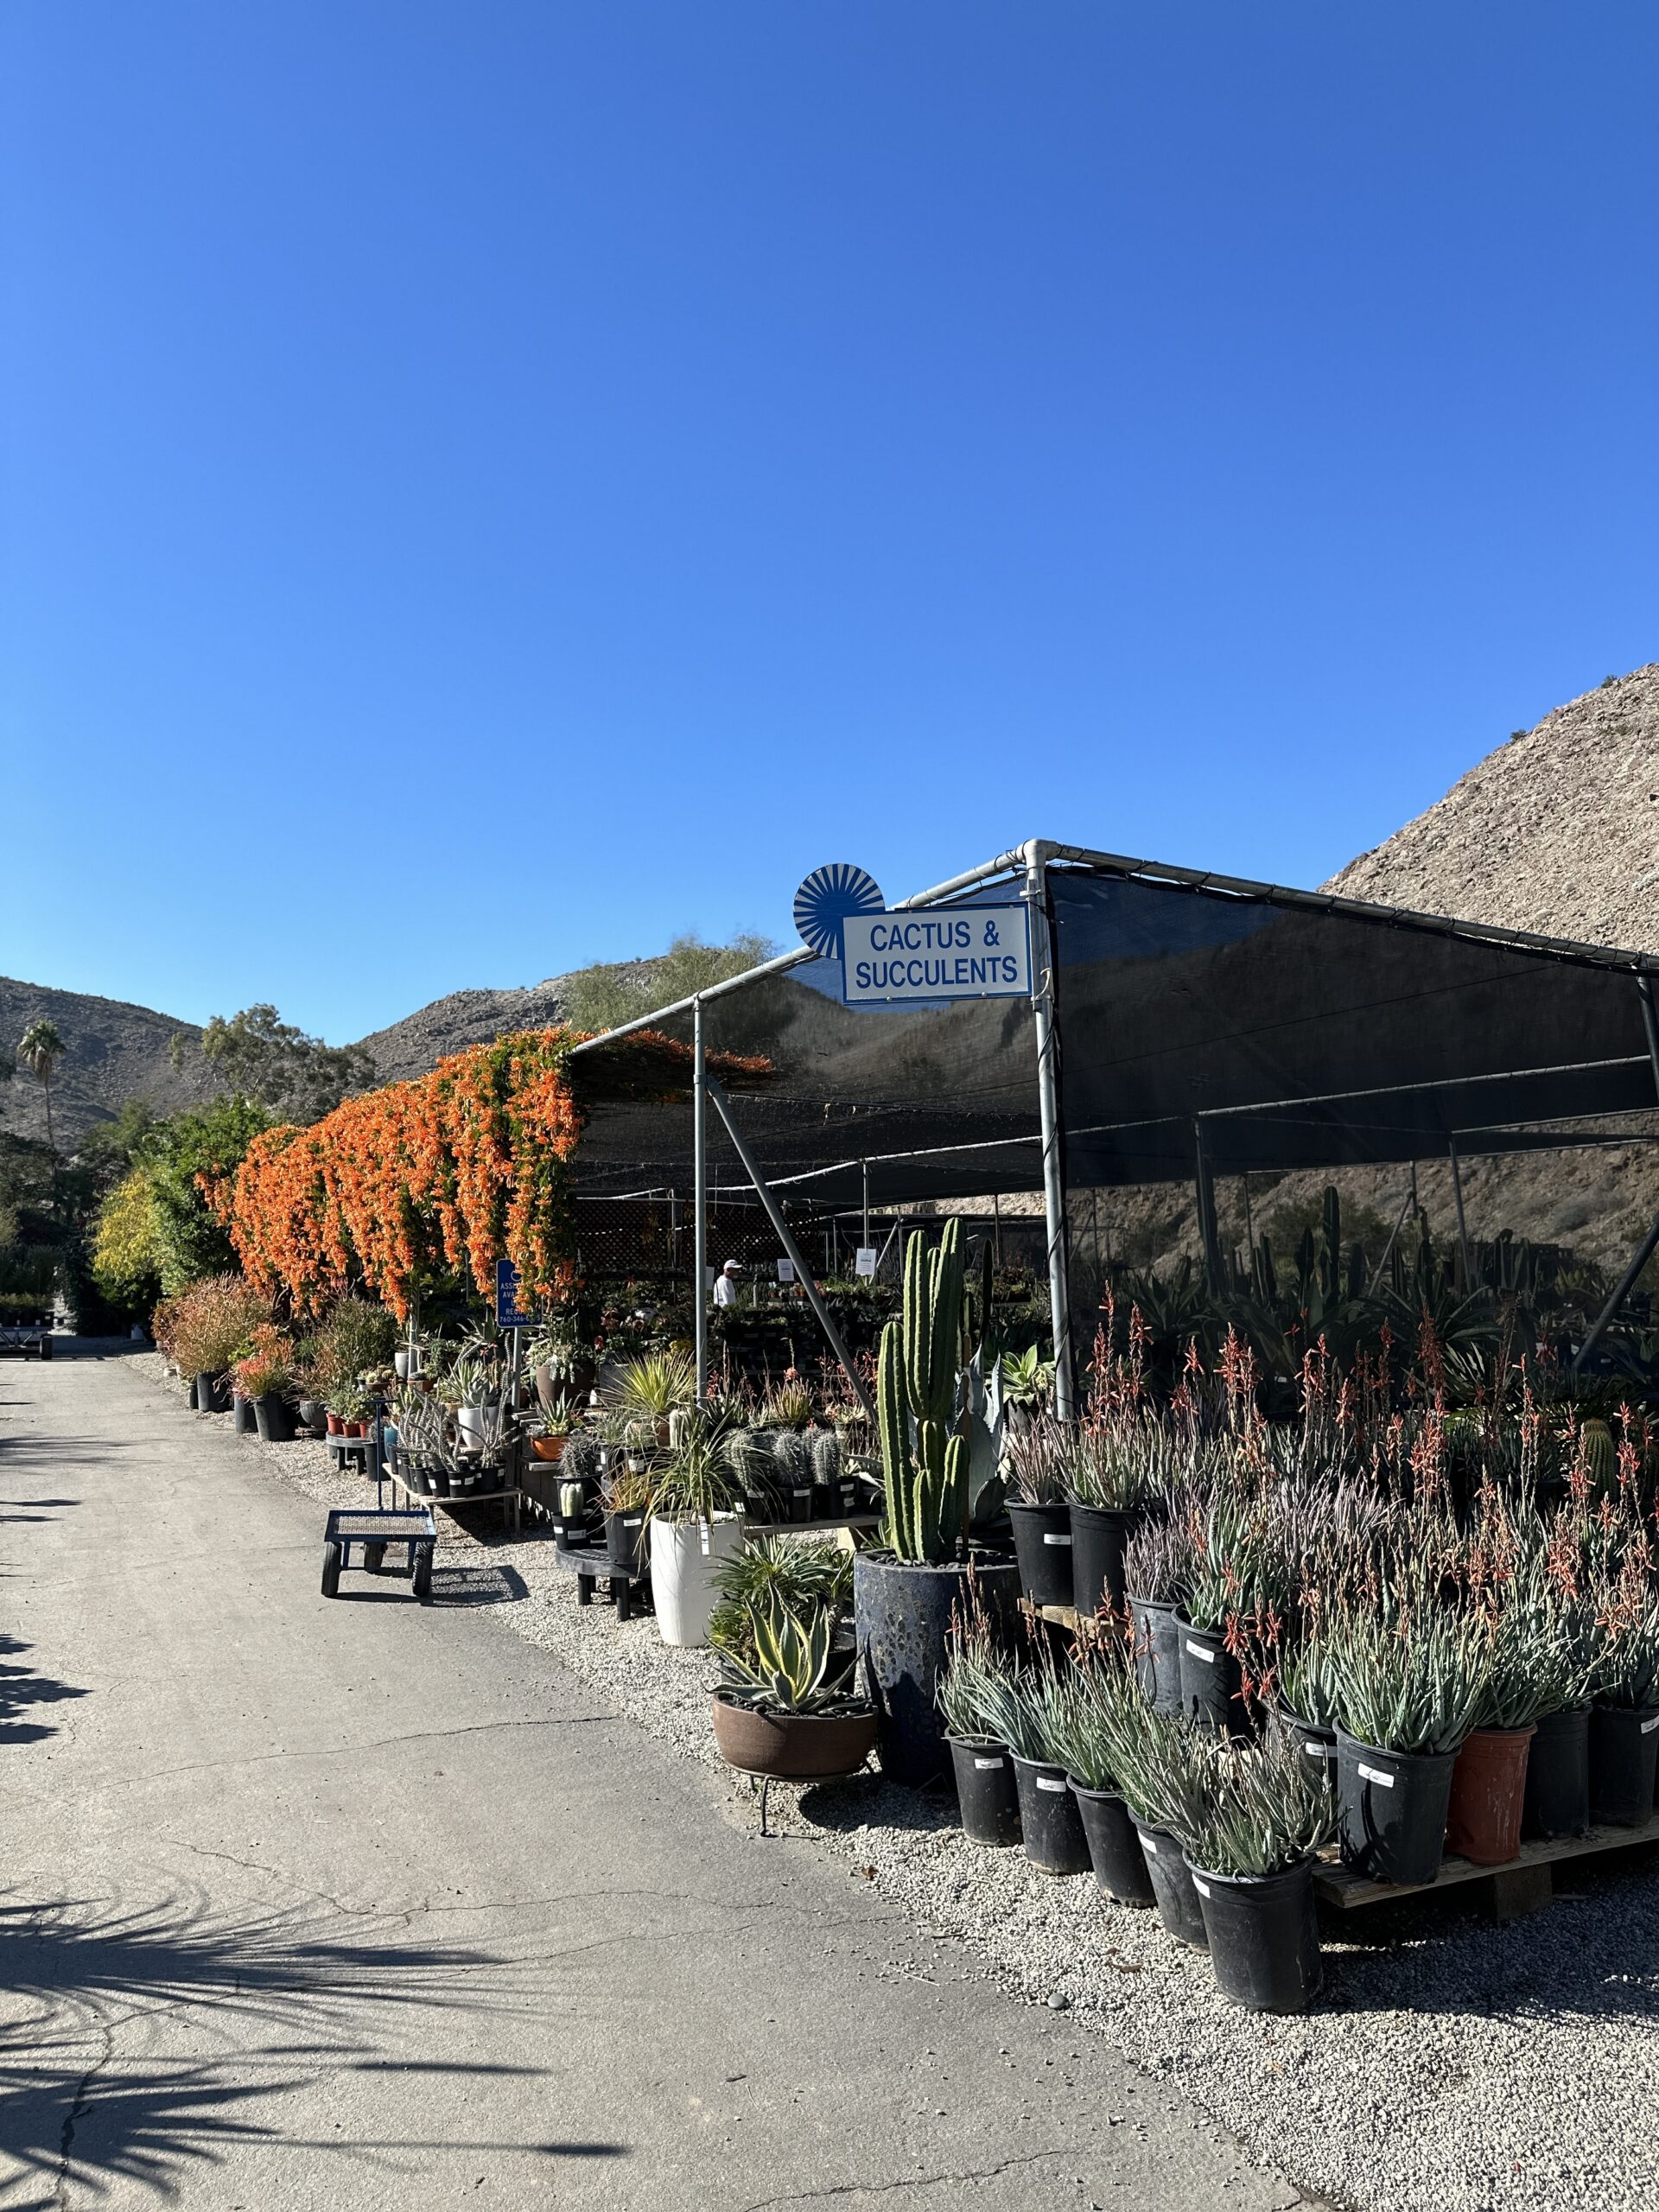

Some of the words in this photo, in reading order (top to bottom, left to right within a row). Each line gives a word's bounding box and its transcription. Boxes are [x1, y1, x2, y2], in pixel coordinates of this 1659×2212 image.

[870, 921, 970, 951] CACTUS
[983, 919, 1000, 947] &
[855, 956, 1018, 988] SUCCULENTS
